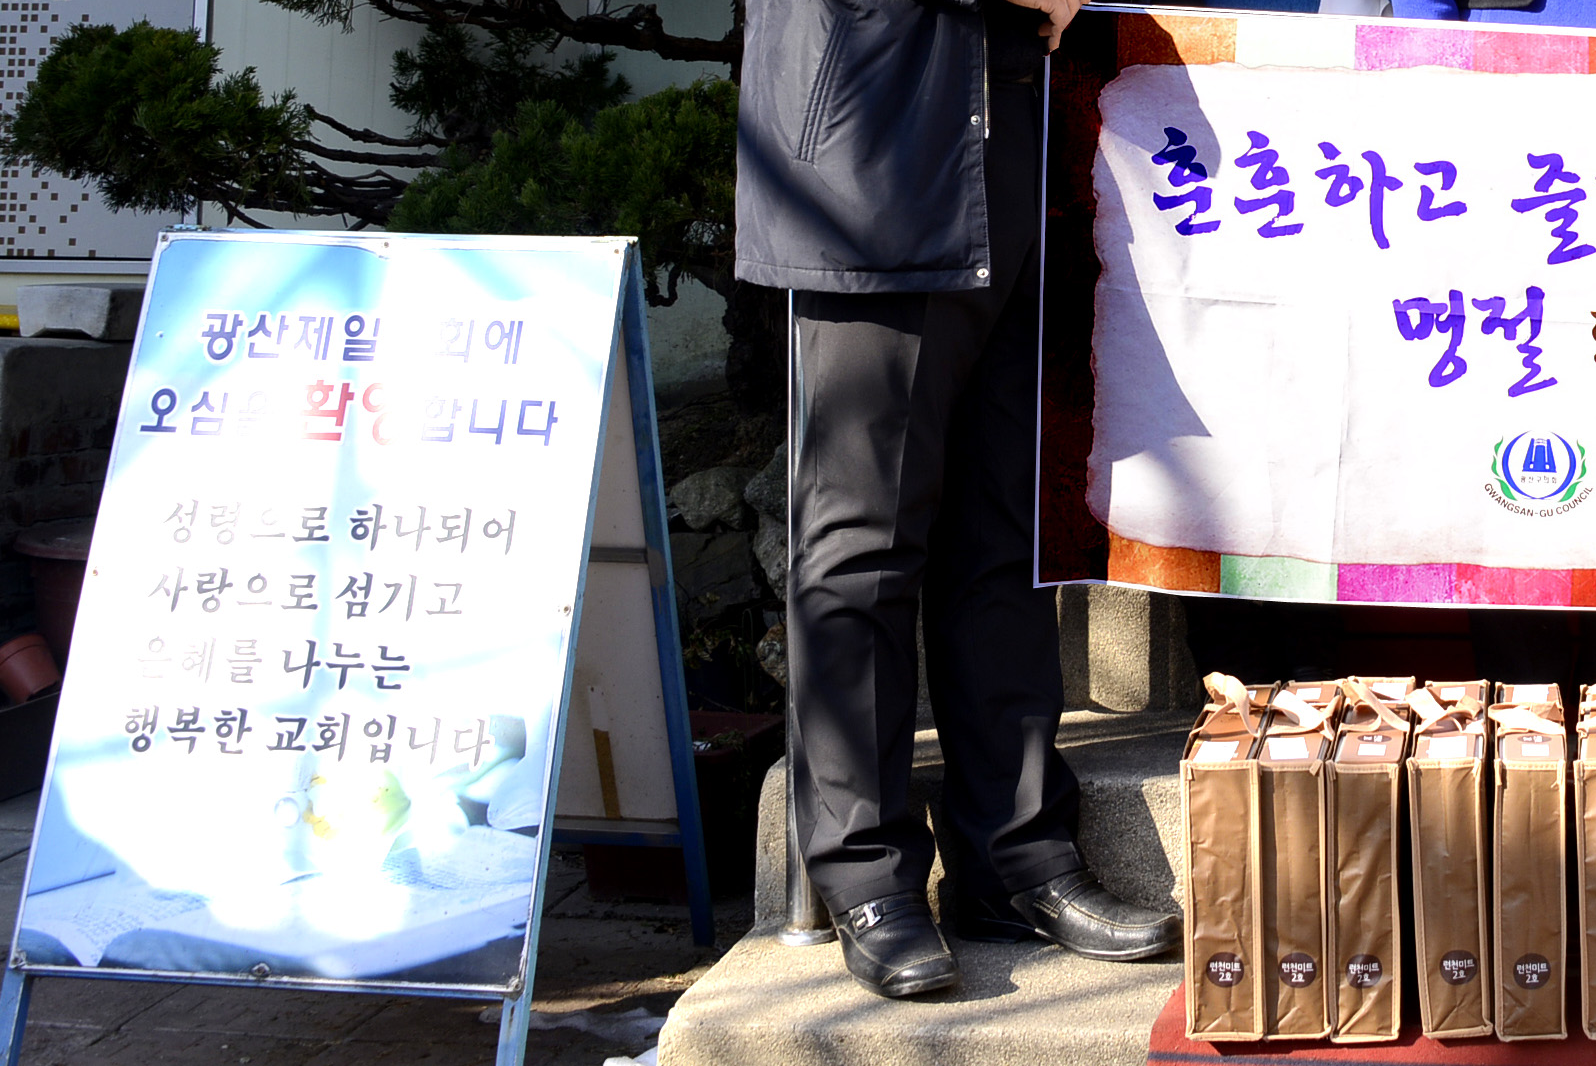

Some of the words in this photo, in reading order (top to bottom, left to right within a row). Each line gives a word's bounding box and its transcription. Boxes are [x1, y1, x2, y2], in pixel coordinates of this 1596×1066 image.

[1152, 127, 1468, 248] 훈훈하고
[201, 312, 524, 365] 광산제일회에
[1393, 285, 1560, 399] 명절
[163, 499, 330, 545] 성령으로
[349, 504, 517, 555] 하나되어
[1484, 483, 1554, 517] GWANGSAN-GU
[1556, 487, 1594, 514] COUNCIL
[148, 566, 320, 614] 사랑으로
[335, 572, 464, 621] 섬기고
[138, 636, 263, 684] 은혜를
[282, 639, 411, 691] 나누는
[125, 704, 253, 755] 행복한
[266, 712, 491, 767] 교회입니다
